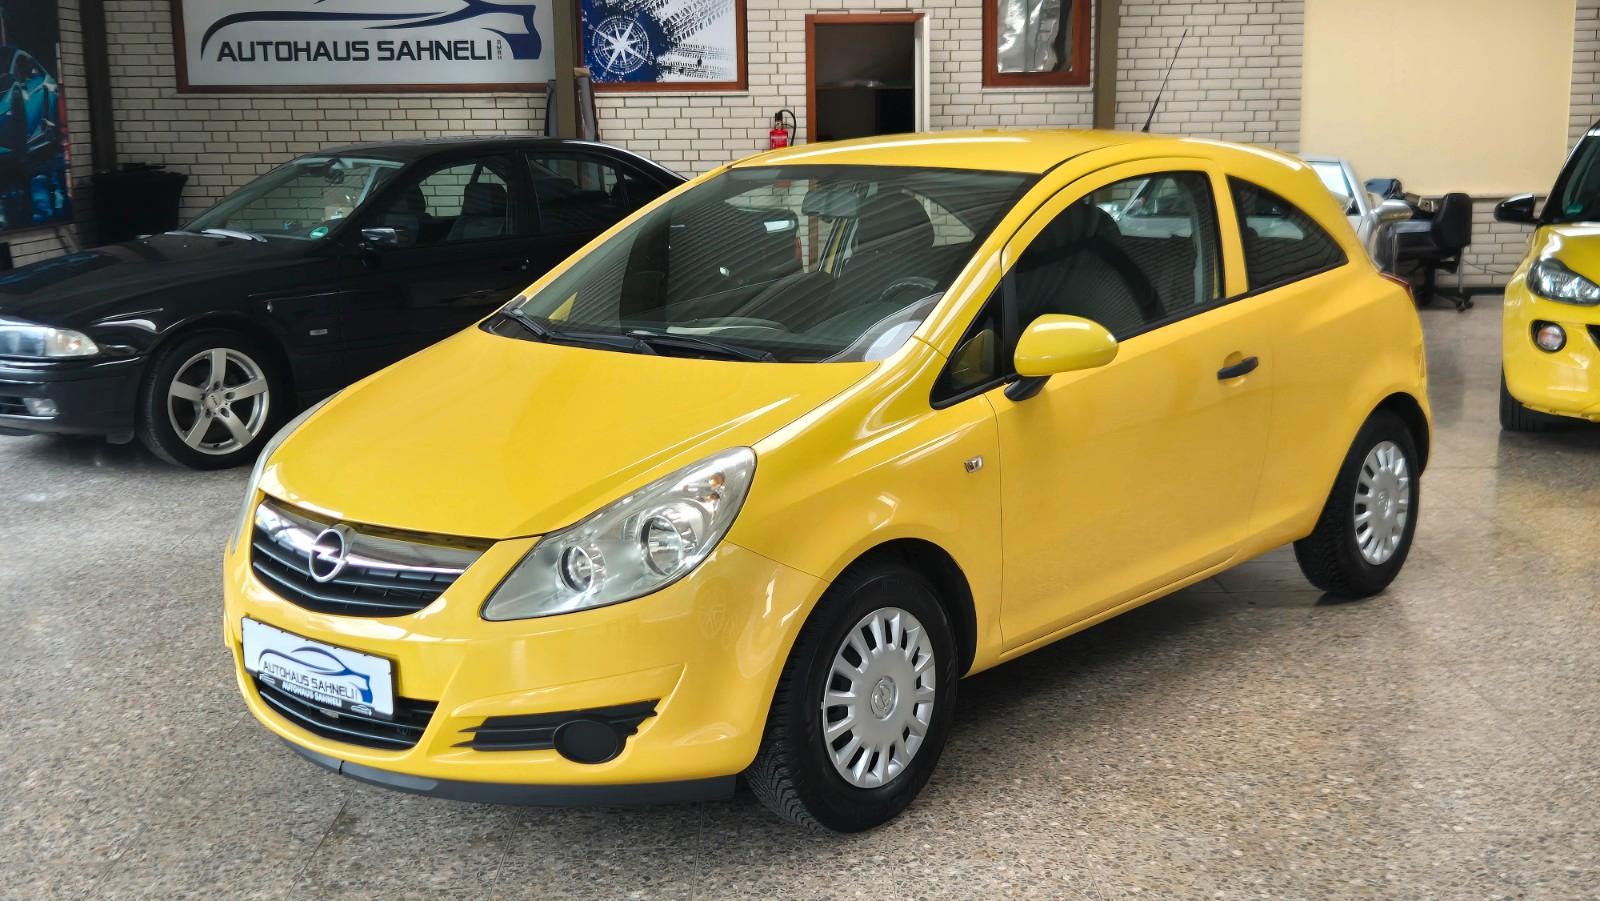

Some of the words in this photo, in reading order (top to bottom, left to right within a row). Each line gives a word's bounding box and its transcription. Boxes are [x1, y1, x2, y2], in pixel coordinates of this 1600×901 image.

[216, 40, 370, 62] AUTOHAUS
[377, 39, 492, 61] SAHNELI
[263, 661, 310, 687] AUTOHAUS
[311, 678, 354, 700] SAHNELI
[282, 681, 314, 699] AUTOHAUS
